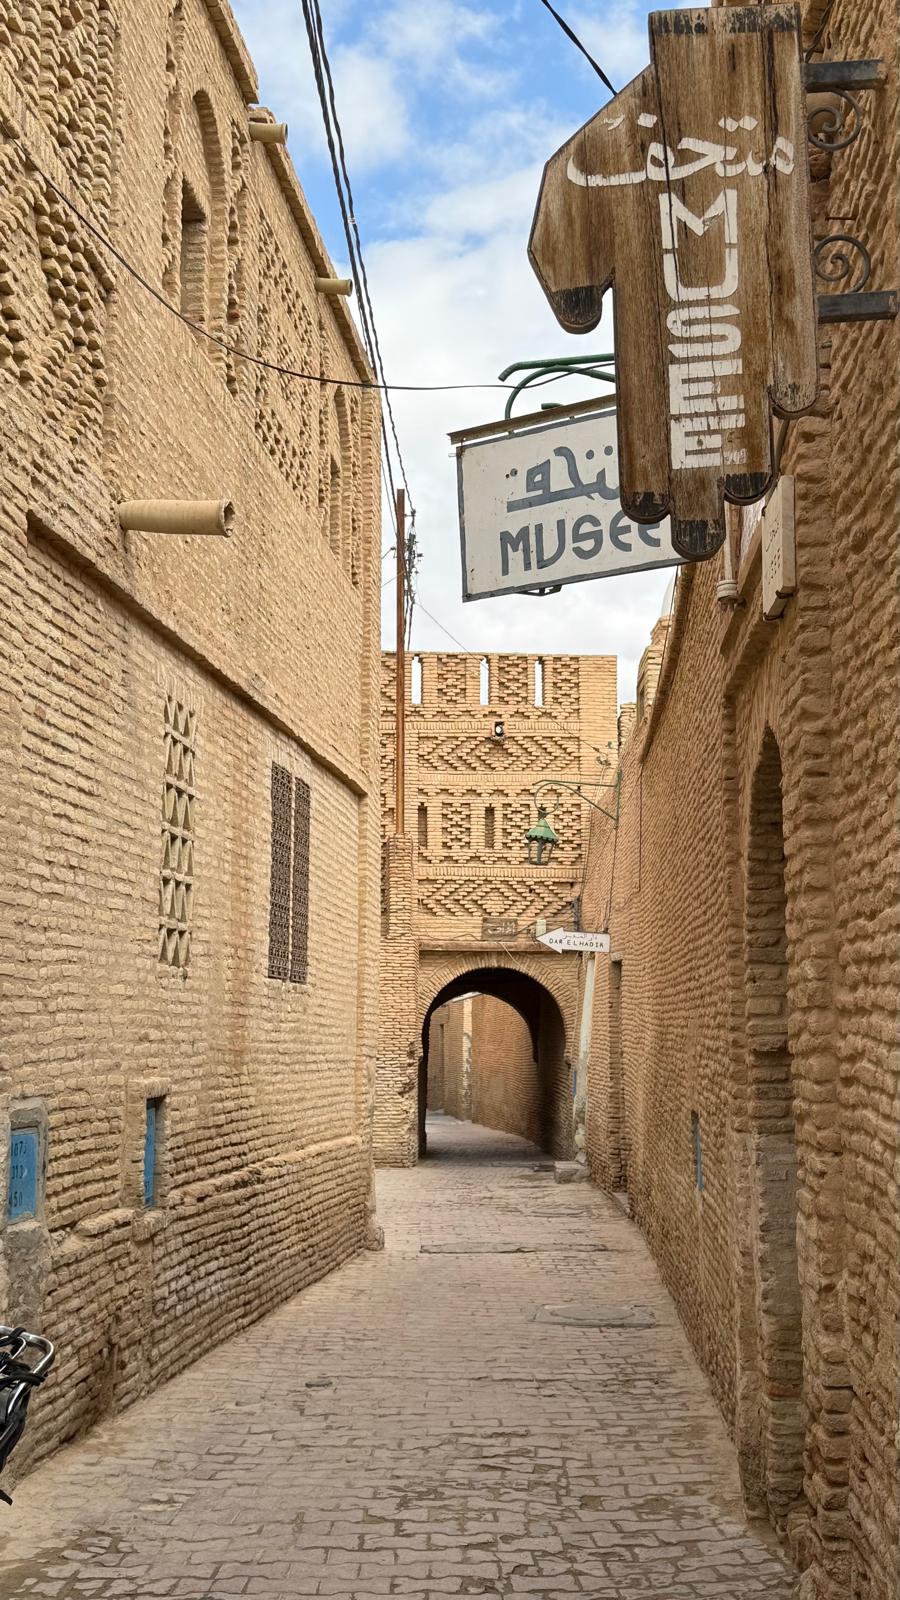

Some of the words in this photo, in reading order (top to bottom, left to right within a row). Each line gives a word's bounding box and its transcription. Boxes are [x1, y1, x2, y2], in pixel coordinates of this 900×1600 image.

[566, 112, 795, 187] متحف
[658, 188, 747, 470] MUSEE
[506, 445, 620, 514] تحف
[548, 937, 563, 945] DAR
